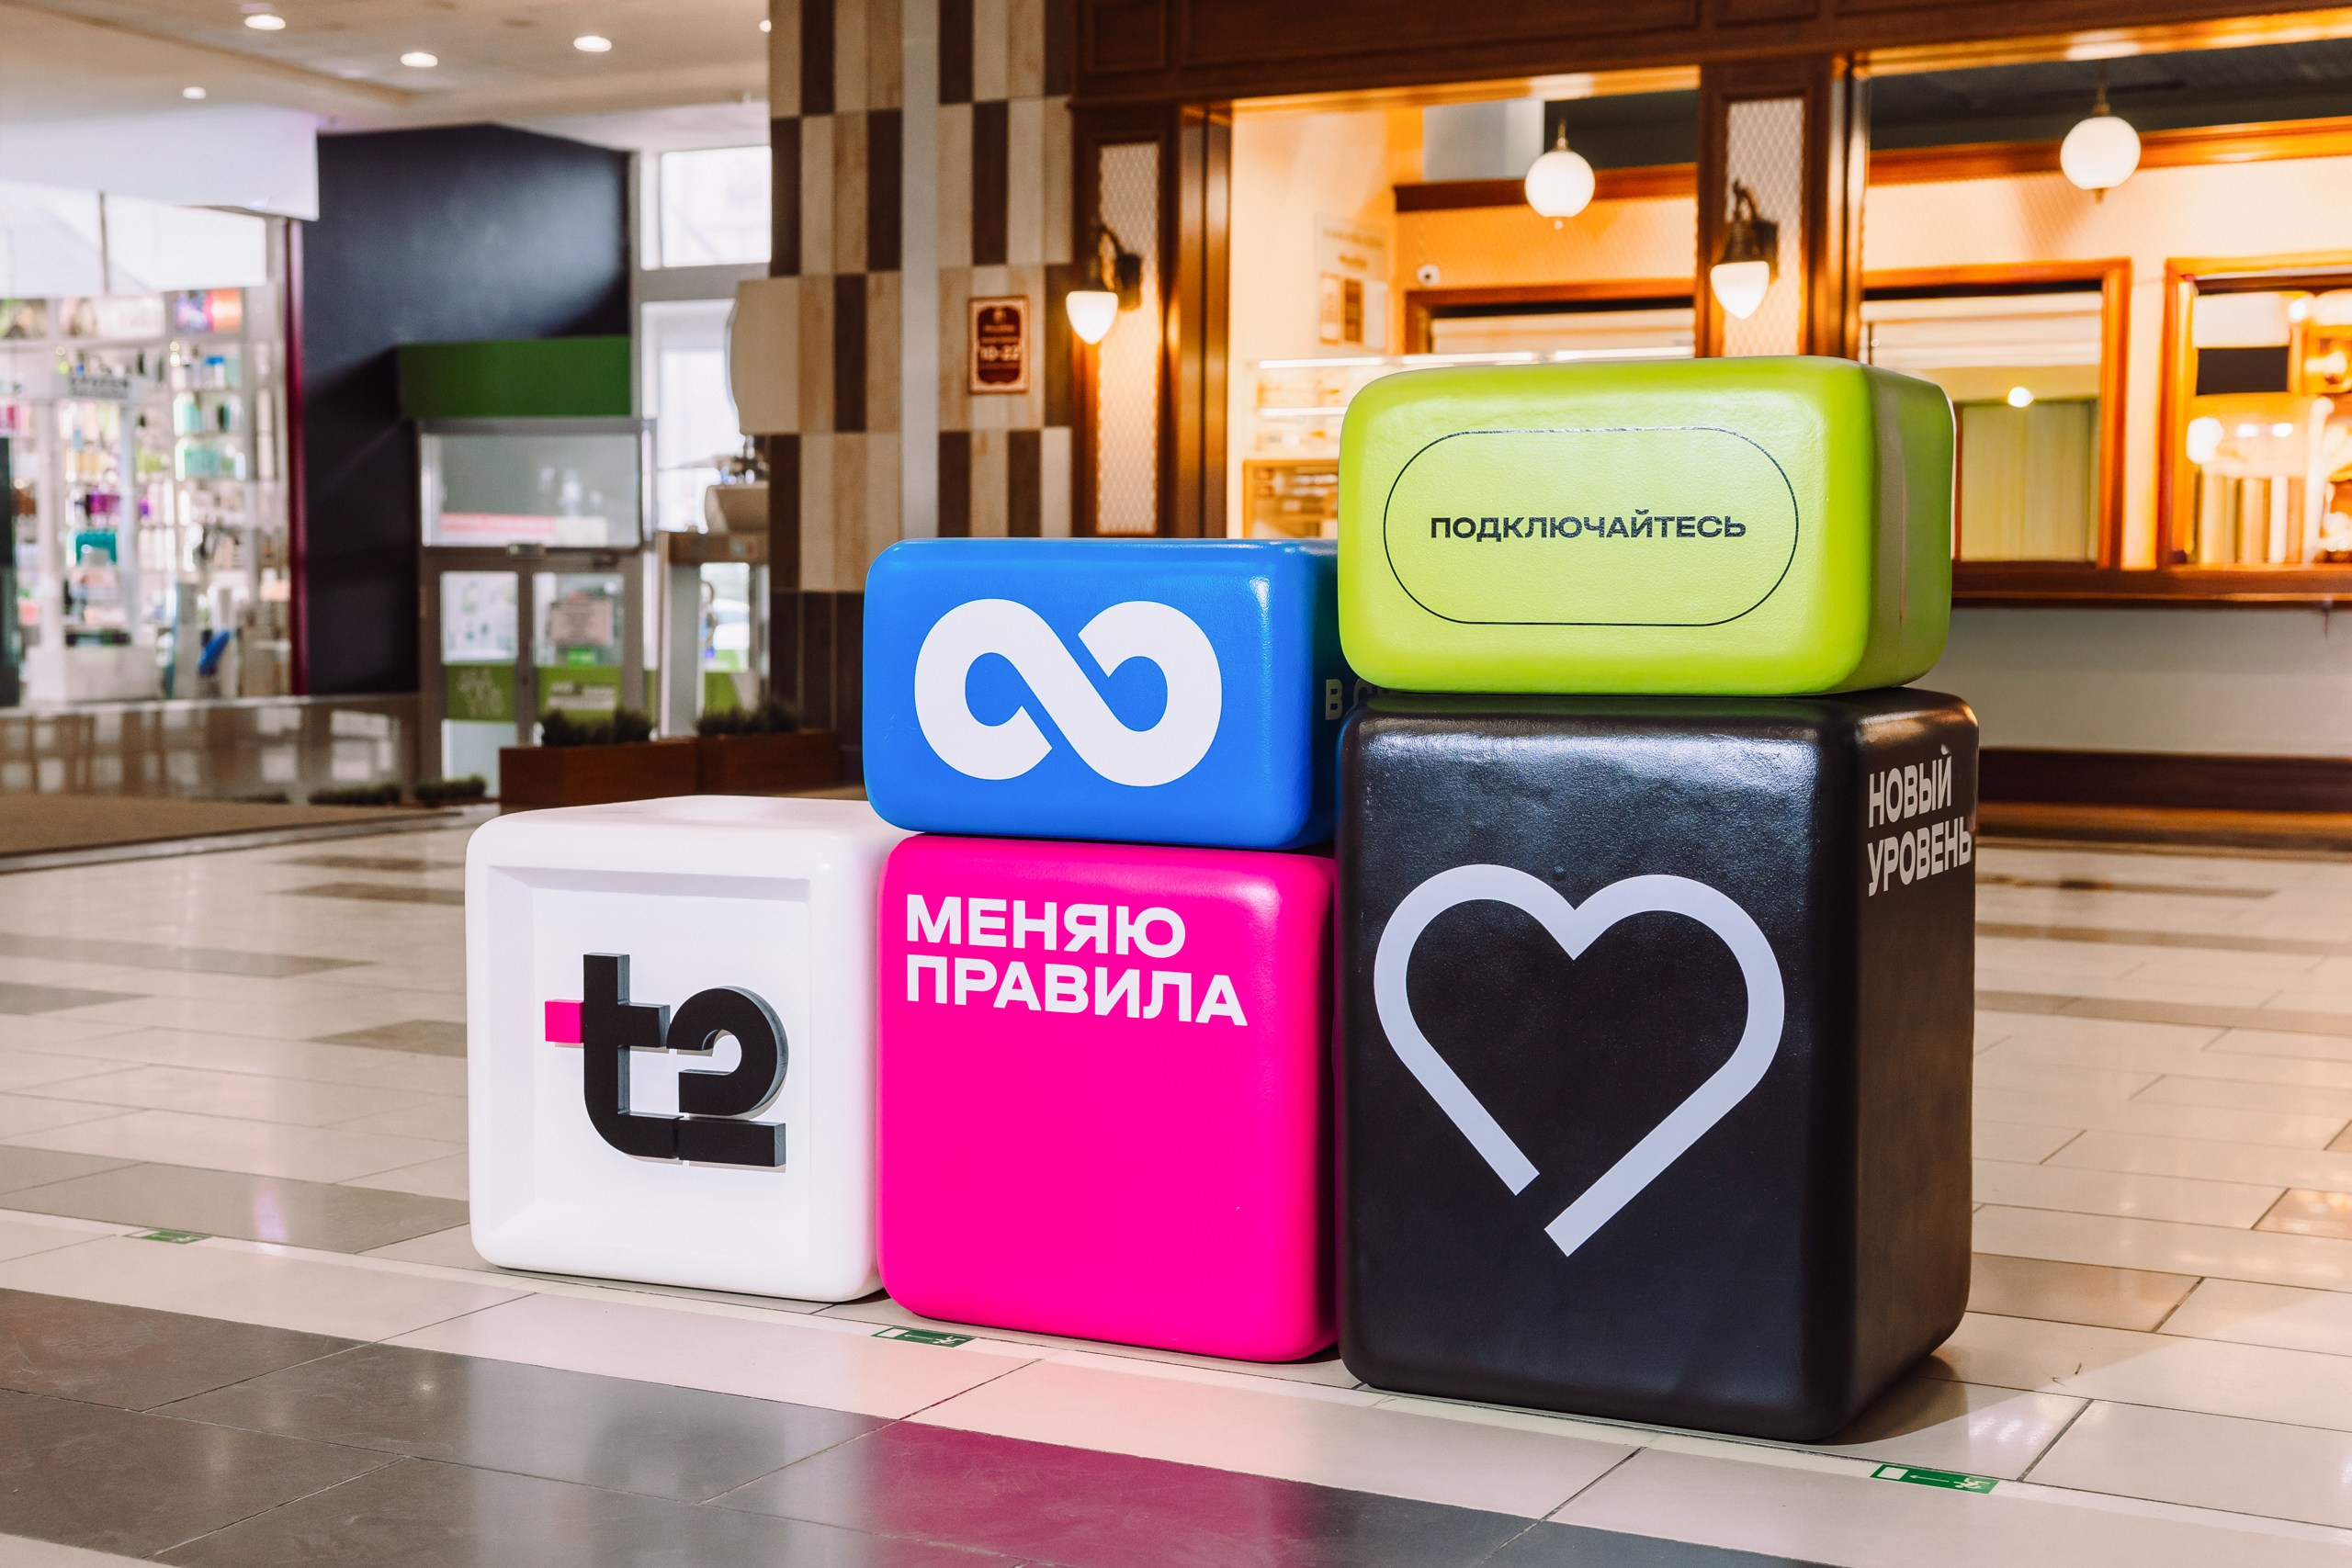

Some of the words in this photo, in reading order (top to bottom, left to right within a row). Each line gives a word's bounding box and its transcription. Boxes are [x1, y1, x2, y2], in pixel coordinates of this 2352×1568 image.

[1430, 509, 1747, 543] ПОДКЛЮЧАЙТЕСЬ
[1868, 744, 1952, 829] НОВЫЙ
[1867, 816, 1973, 897] УРОВЕНЬ
[906, 894, 1186, 959] МЕНЯЮ
[906, 953, 1249, 1026] ПРАВИЛА
[544, 952, 789, 1168] t2
